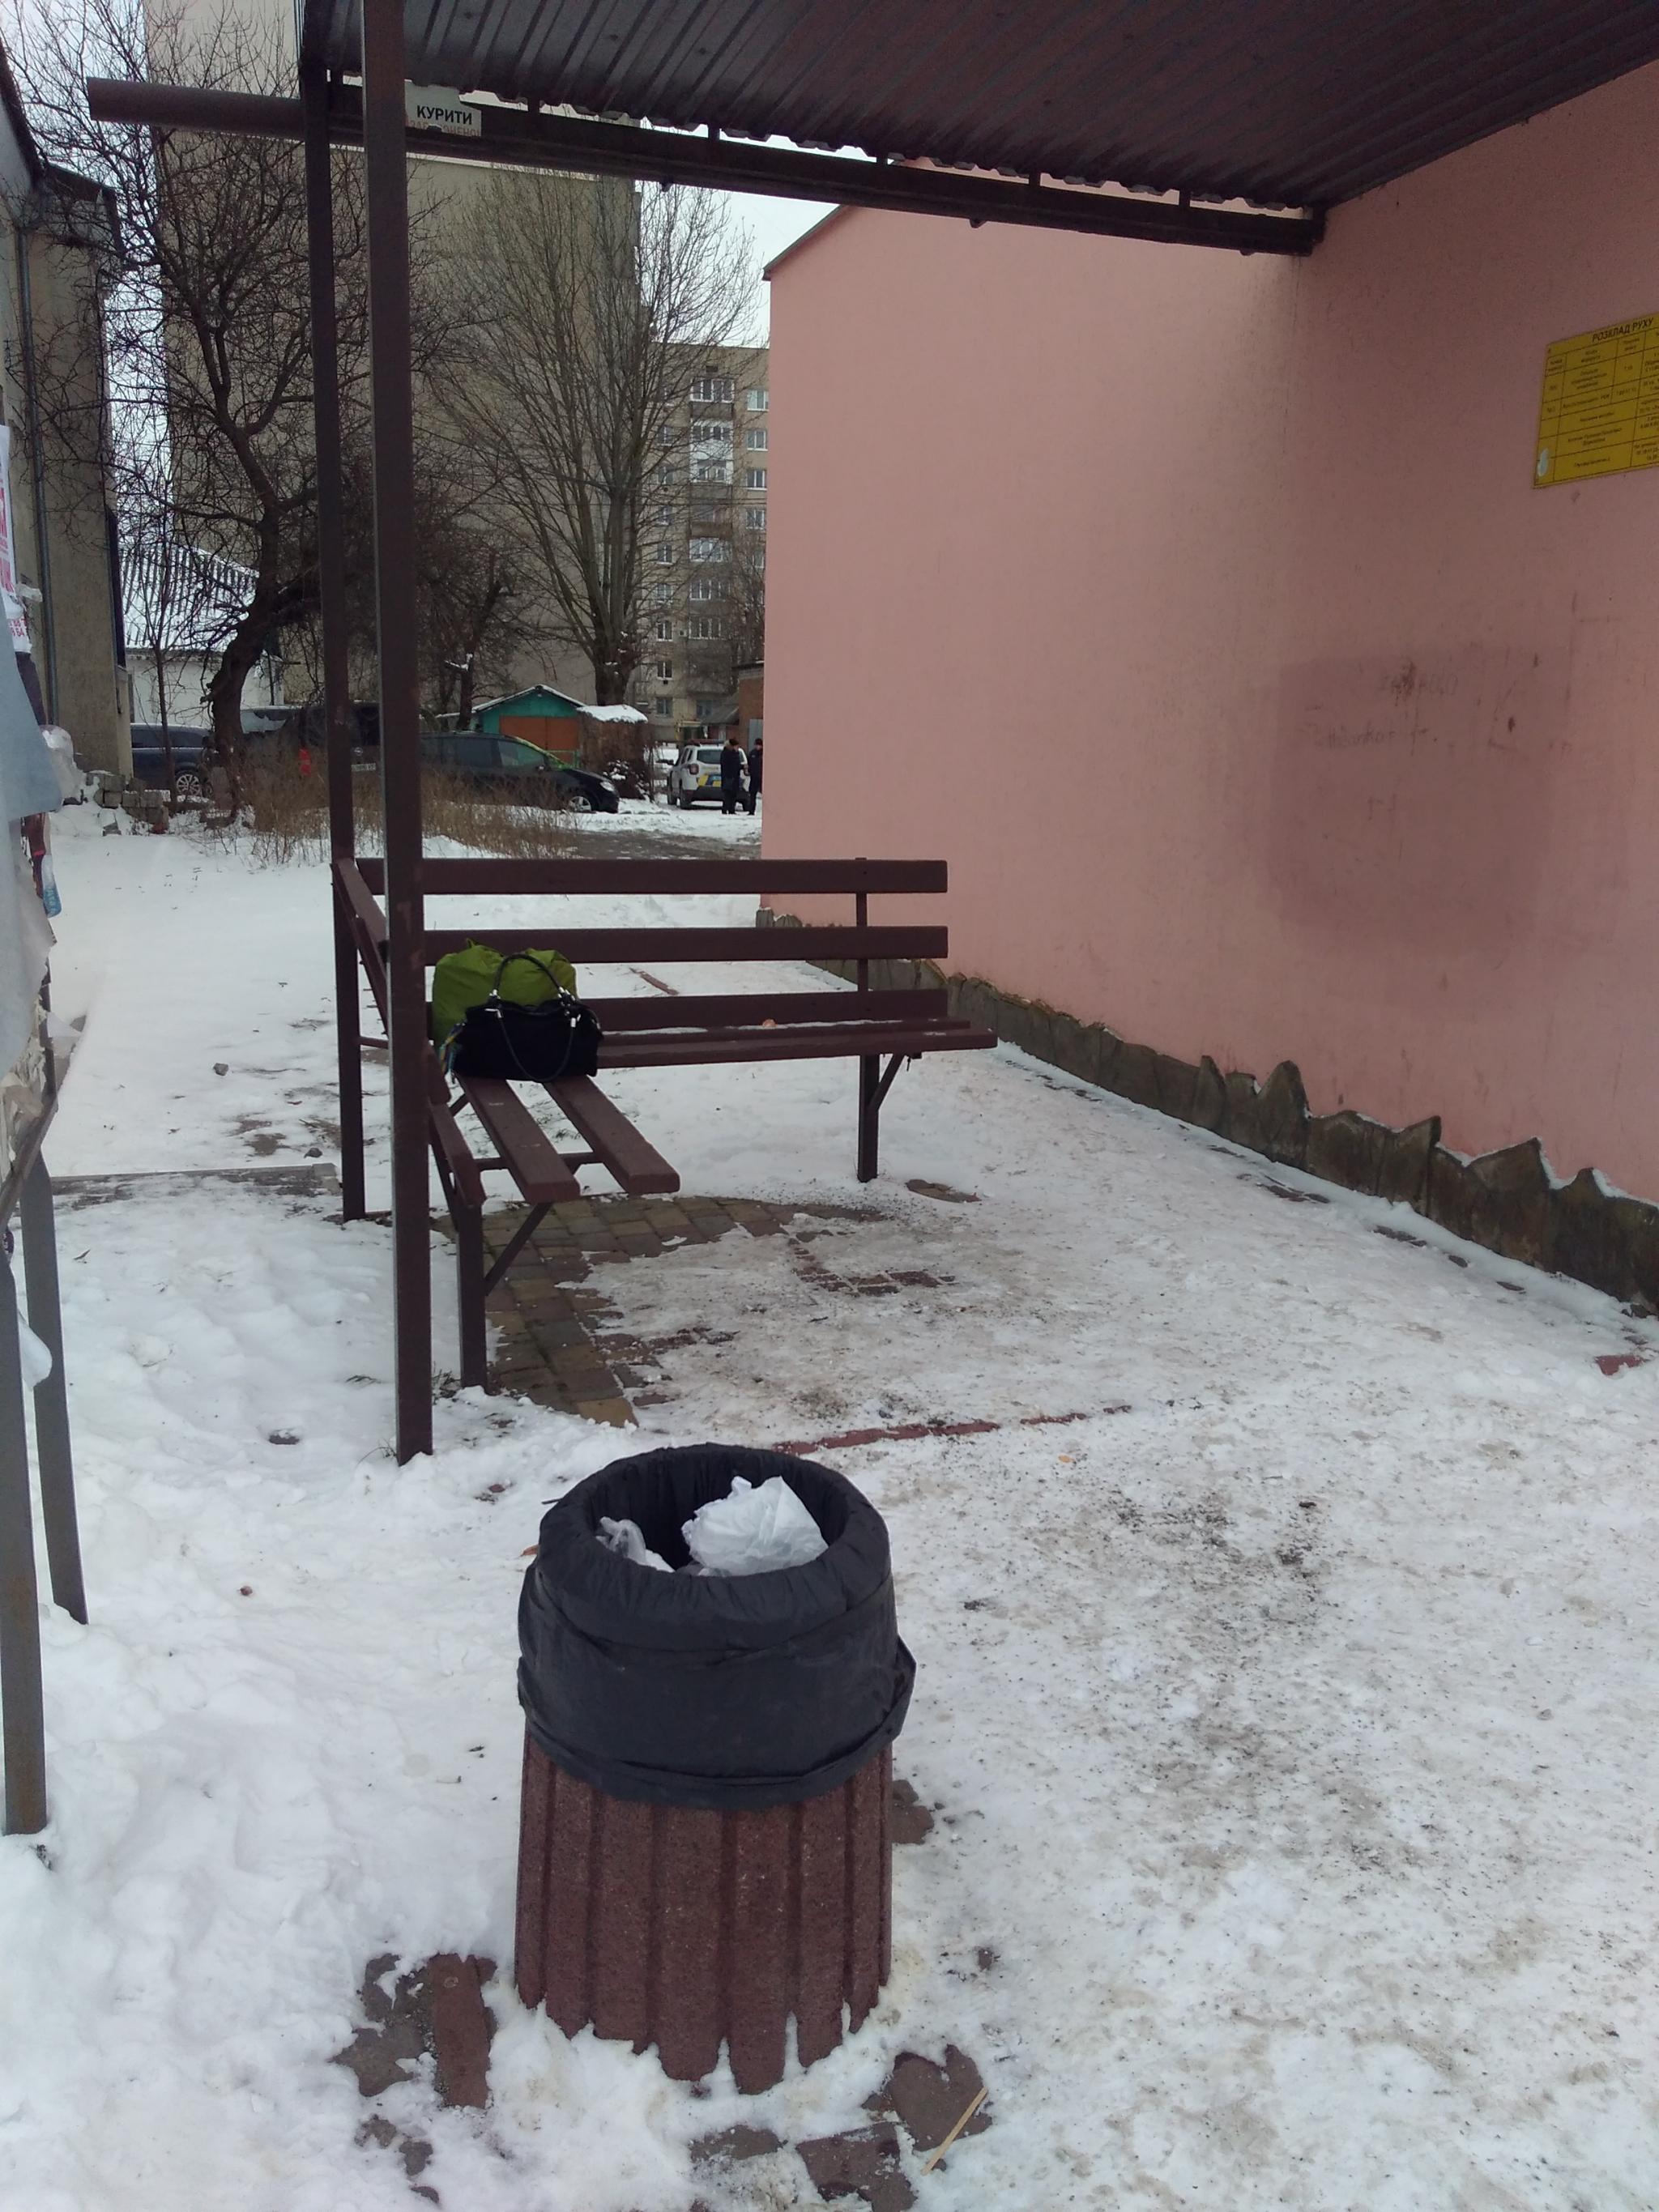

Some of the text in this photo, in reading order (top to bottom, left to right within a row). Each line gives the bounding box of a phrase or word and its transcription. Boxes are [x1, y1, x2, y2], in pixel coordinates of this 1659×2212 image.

[416, 105, 472, 125] КУРИТИ
[1592, 317, 1653, 342] РОЗКЛАД РУХУ
